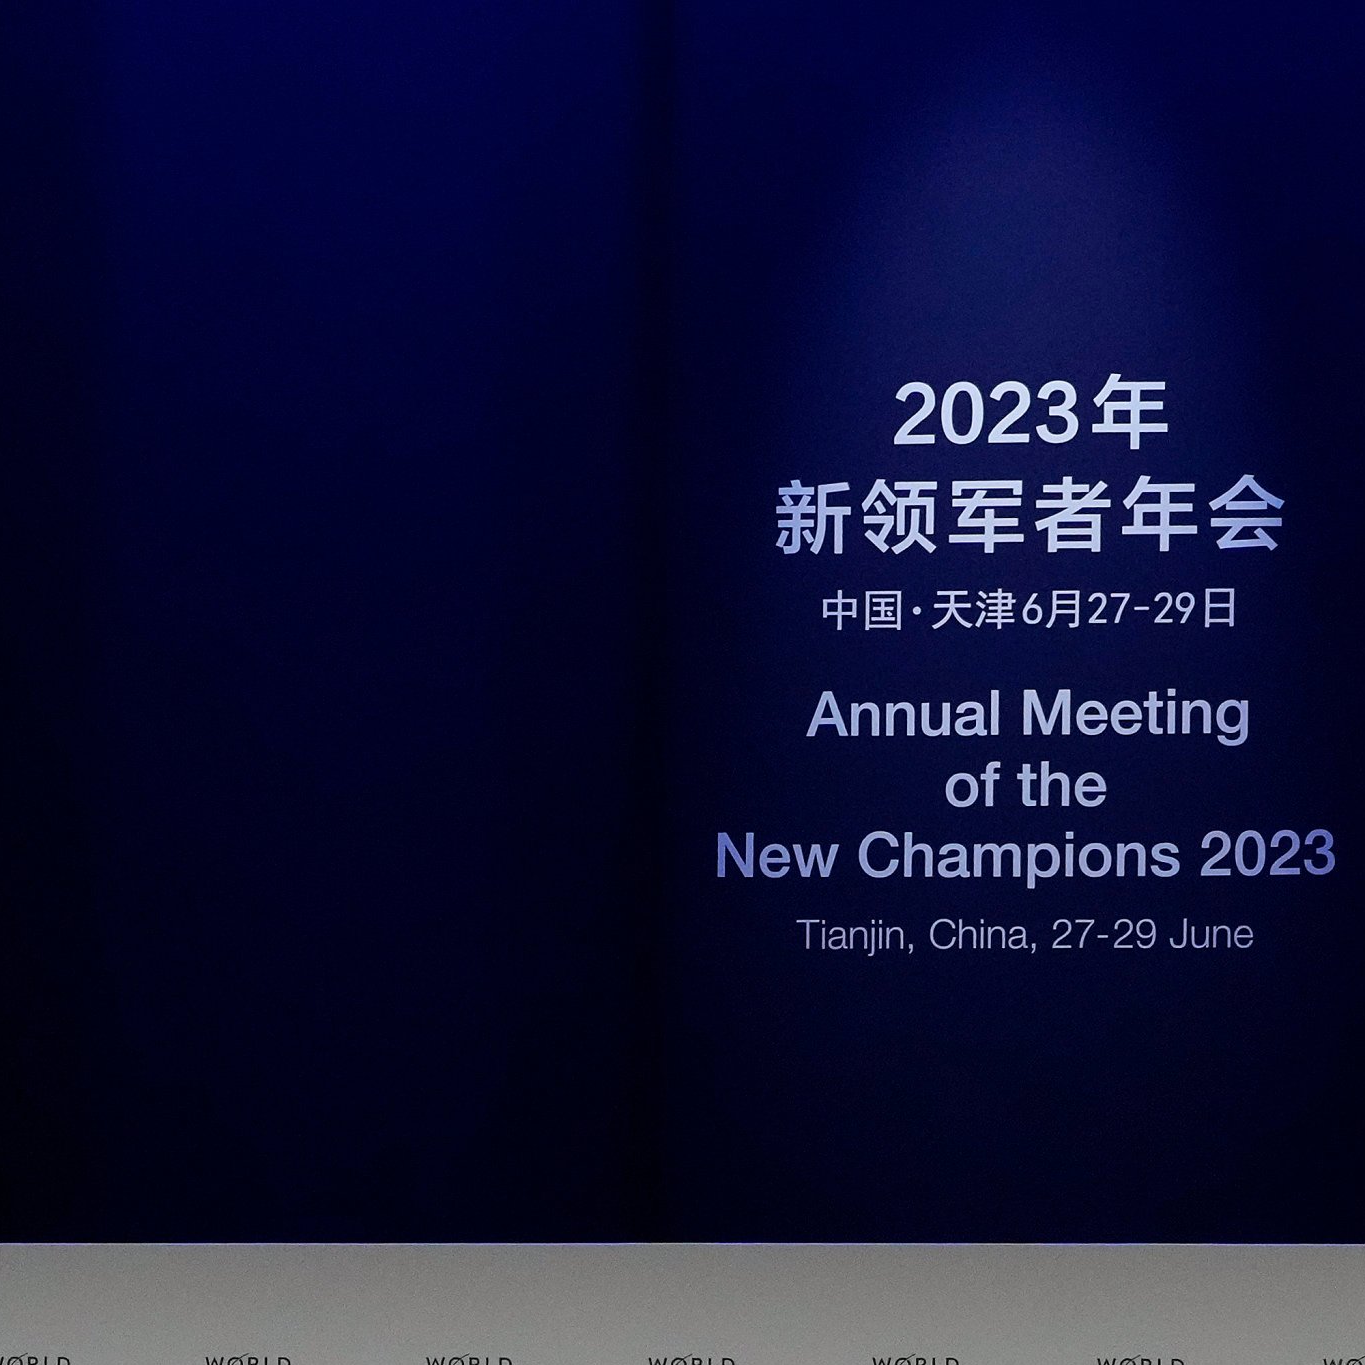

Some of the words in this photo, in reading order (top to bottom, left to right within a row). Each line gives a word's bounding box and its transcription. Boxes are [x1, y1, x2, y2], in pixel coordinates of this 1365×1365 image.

[893, 372, 1169, 450] 2023年
[775, 473, 1286, 555] 新领军者年会
[805, 689, 1000, 737] Annual
[1022, 687, 1249, 747] Meeting
[945, 760, 1002, 808] of
[1016, 760, 1107, 808] the
[717, 831, 840, 879] New
[858, 830, 1181, 890] Champions
[1200, 828, 1336, 877] 2023
[795, 919, 914, 957] Tianjin,
[929, 918, 1037, 954] China,
[1051, 918, 1157, 949] 27-29
[1169, 917, 1254, 949] June
